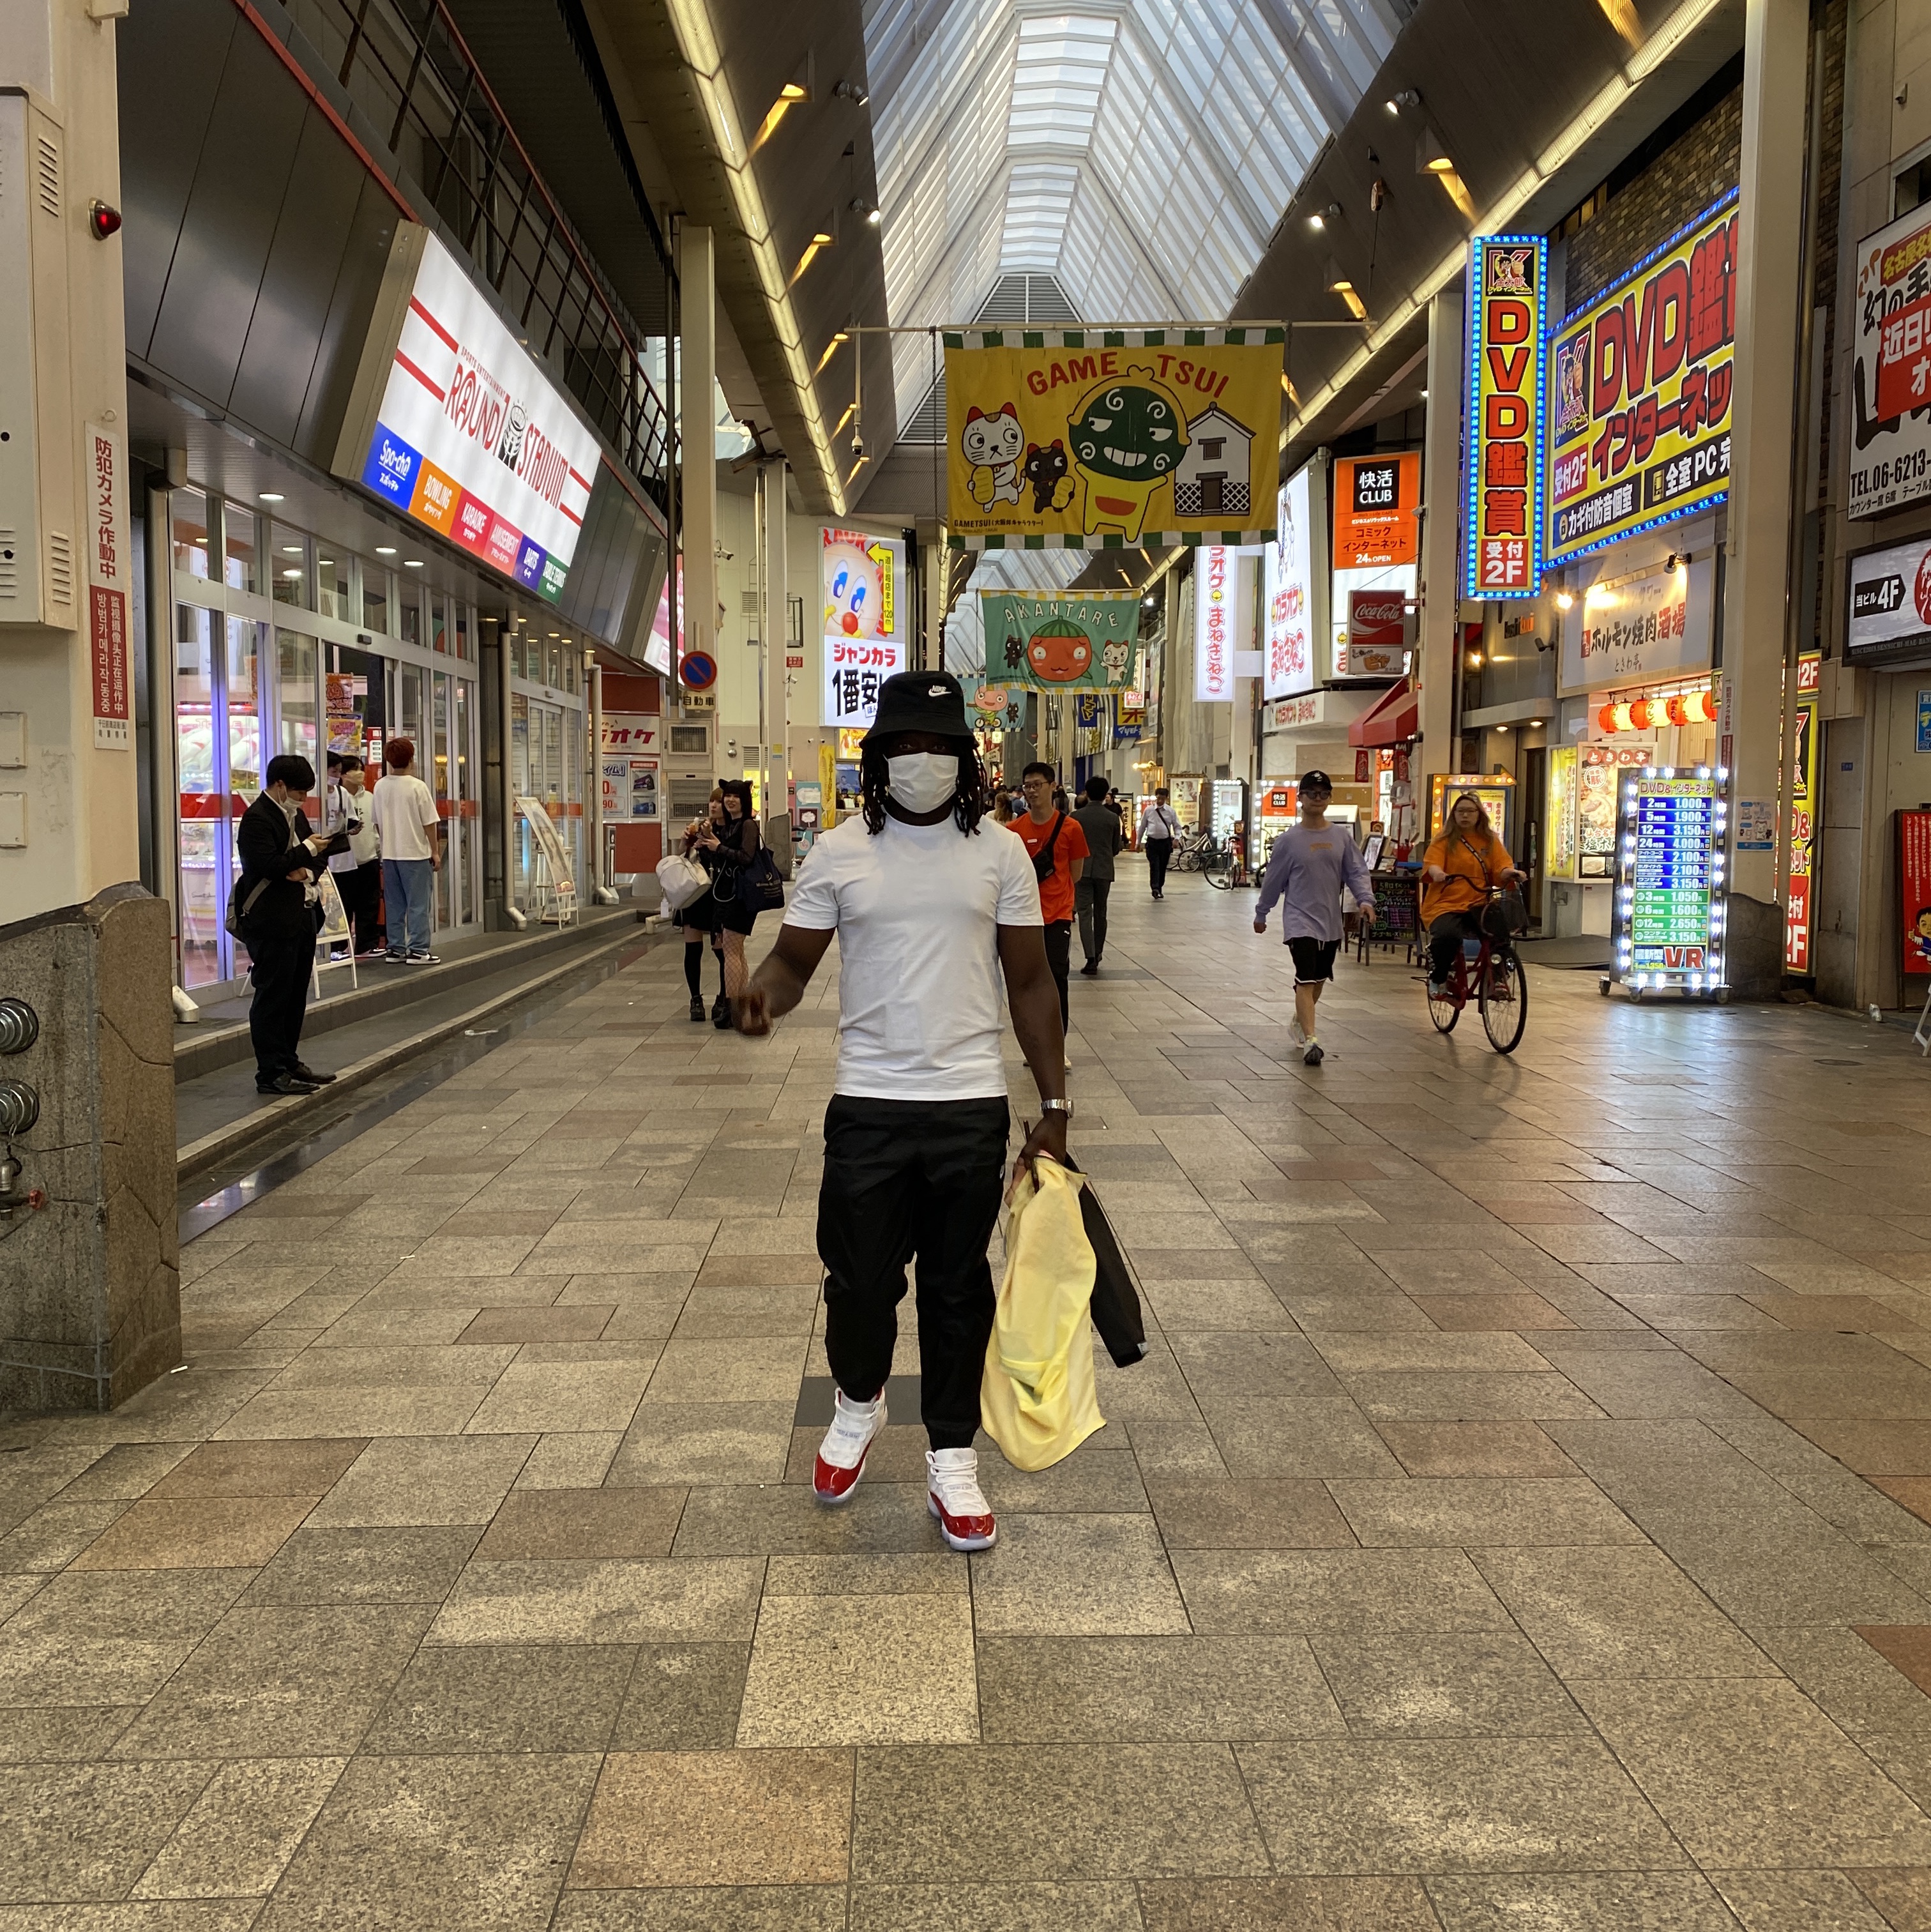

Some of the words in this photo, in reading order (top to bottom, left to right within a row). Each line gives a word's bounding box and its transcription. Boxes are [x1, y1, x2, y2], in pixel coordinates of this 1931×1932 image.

[460, 346, 476, 369] SPORTS
[476, 363, 506, 398] ENTERTAINMENT
[1027, 352, 1118, 395] GAME
[1157, 354, 1229, 399] TSUI
[1484, 299, 1531, 536] DVD鑑賞
[517, 423, 568, 509] STADIUM
[1359, 469, 1393, 489] 快活
[1554, 451, 1587, 496] 受付2F
[1665, 457, 1692, 497] 全室
[1695, 445, 1716, 482] PC
[95, 436, 115, 579] 防犯カメラ作動中
[423, 474, 452, 510] BOWLING
[1360, 490, 1392, 503] CLUB
[461, 502, 487, 534] KARAOKE
[1568, 483, 1633, 537] カギ付防音個室
[490, 524, 519, 556] AMUSEMENT
[1344, 538, 1406, 552] インターネット
[1356, 526, 1391, 538] コミック
[524, 547, 539, 570] DARTS
[1485, 542, 1524, 559] 受付
[1485, 560, 1522, 584] 2F
[1004, 602, 1119, 628] AKANTARE
[1591, 602, 1686, 653] ホルモン焼肉酒場
[96, 592, 110, 713] 방범카메라작동중
[834, 643, 896, 667] ジャンカラ
[1206, 604, 1225, 694] まねきねこ
[1615, 653, 1640, 672] ときわ亭
[683, 696, 715, 706] 自動車
[832, 669, 882, 717] 1番安
[1590, 751, 1647, 763] ときわ亭
[1663, 947, 1704, 969] VR
